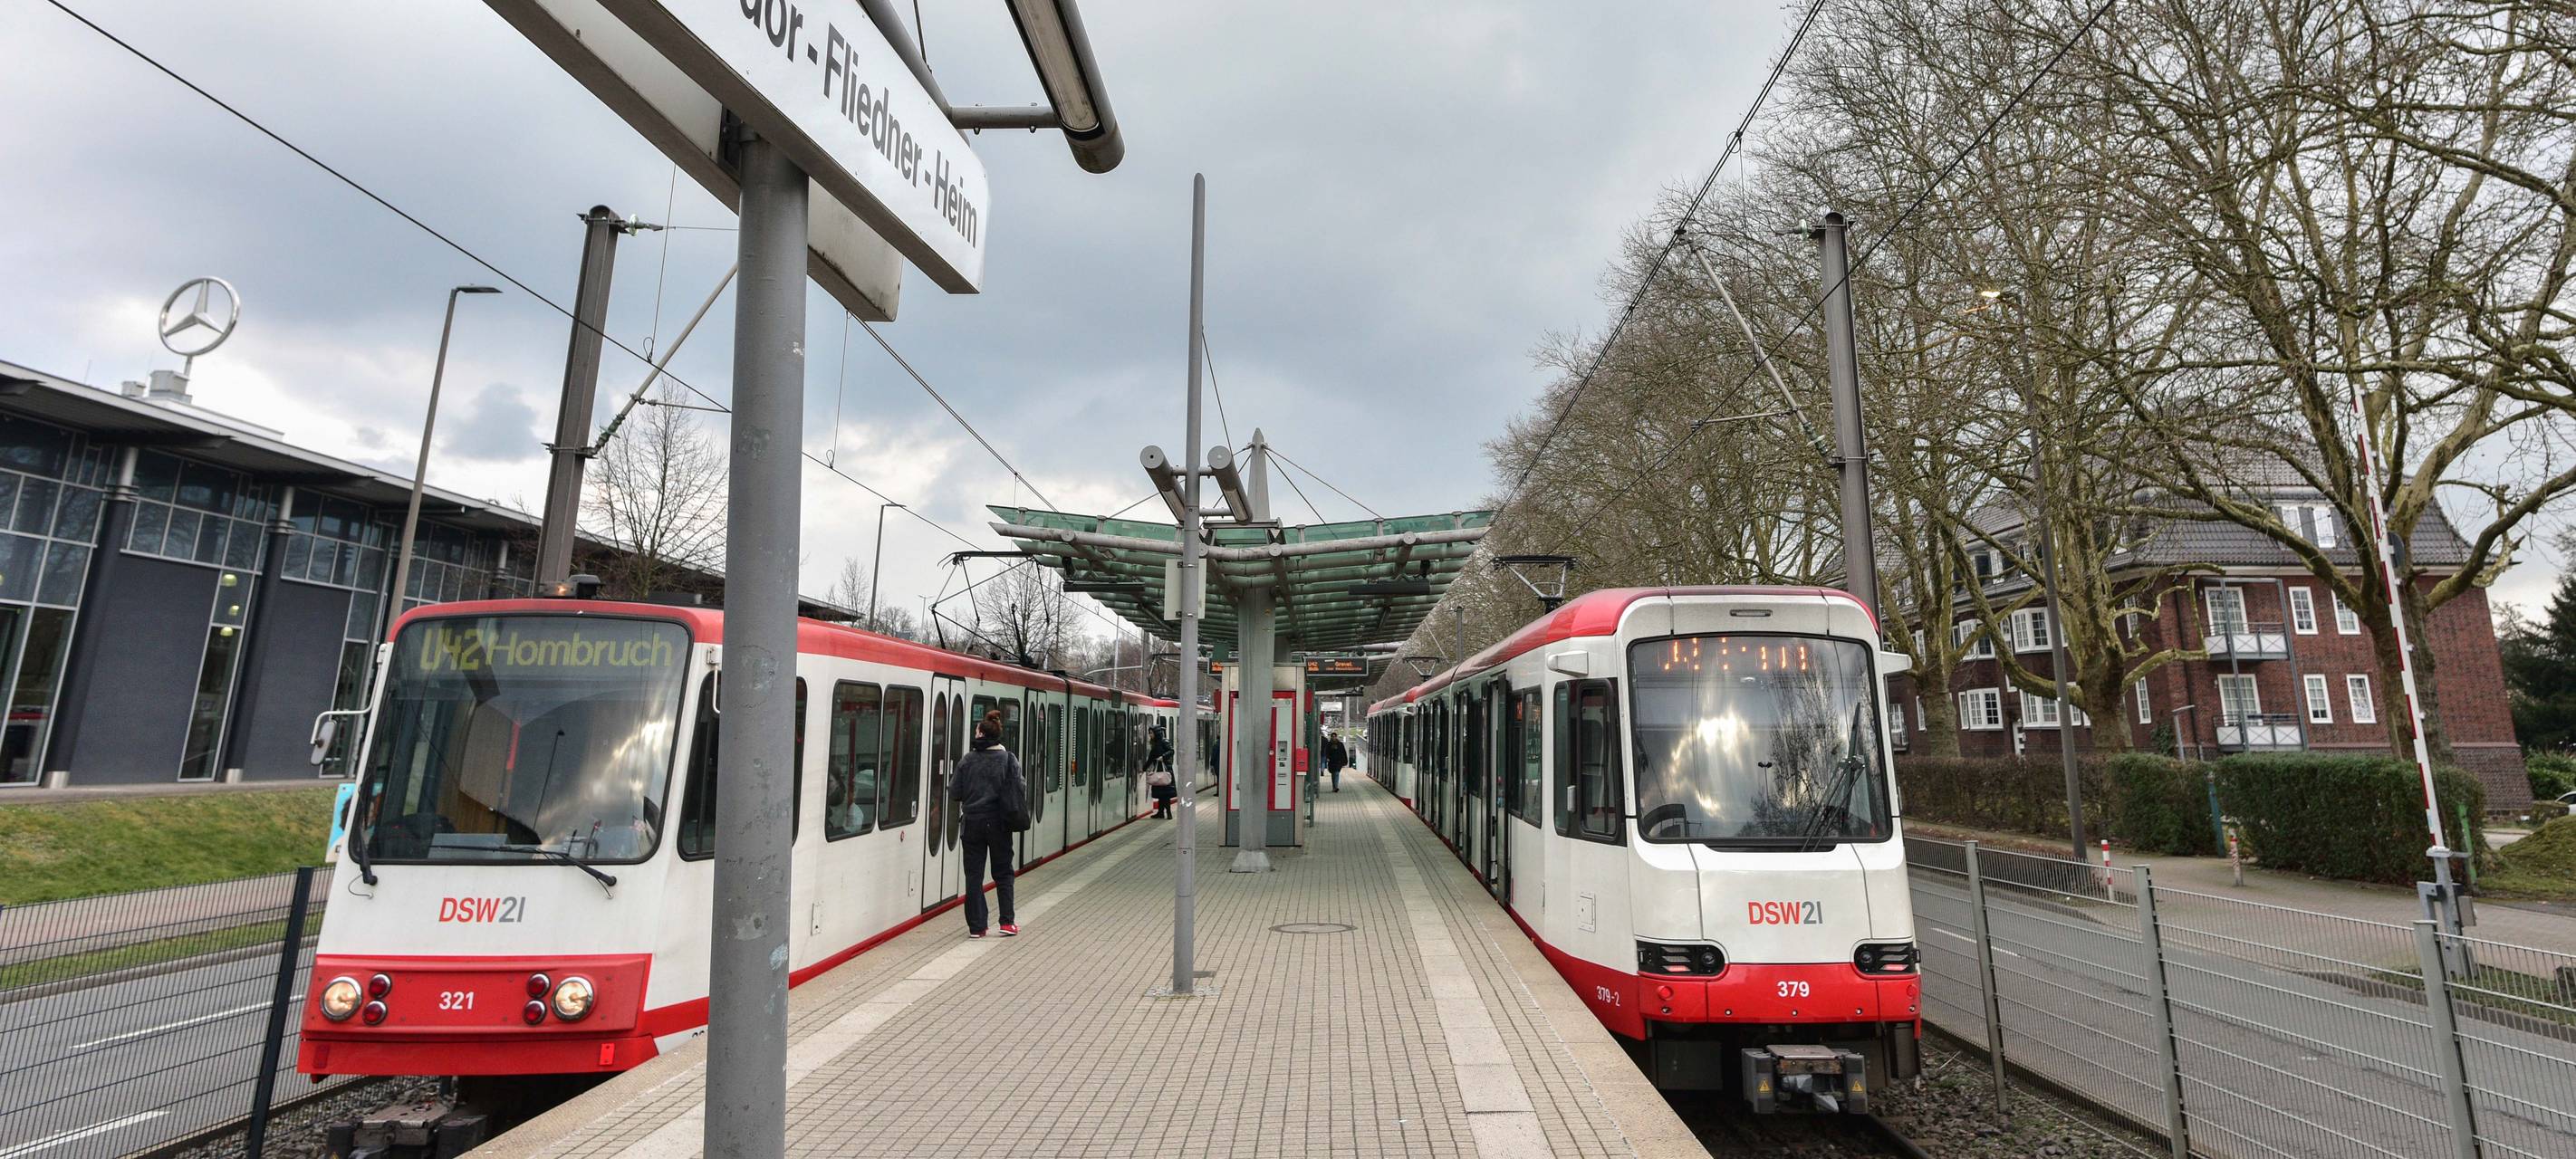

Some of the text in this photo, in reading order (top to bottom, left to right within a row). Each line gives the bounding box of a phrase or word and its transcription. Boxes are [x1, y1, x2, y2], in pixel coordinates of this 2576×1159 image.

[485, 631, 672, 667] Hombruch
[1596, 985, 1620, 1007] 379-2
[1776, 981, 1811, 998] 379
[438, 991, 475, 1011] 321
